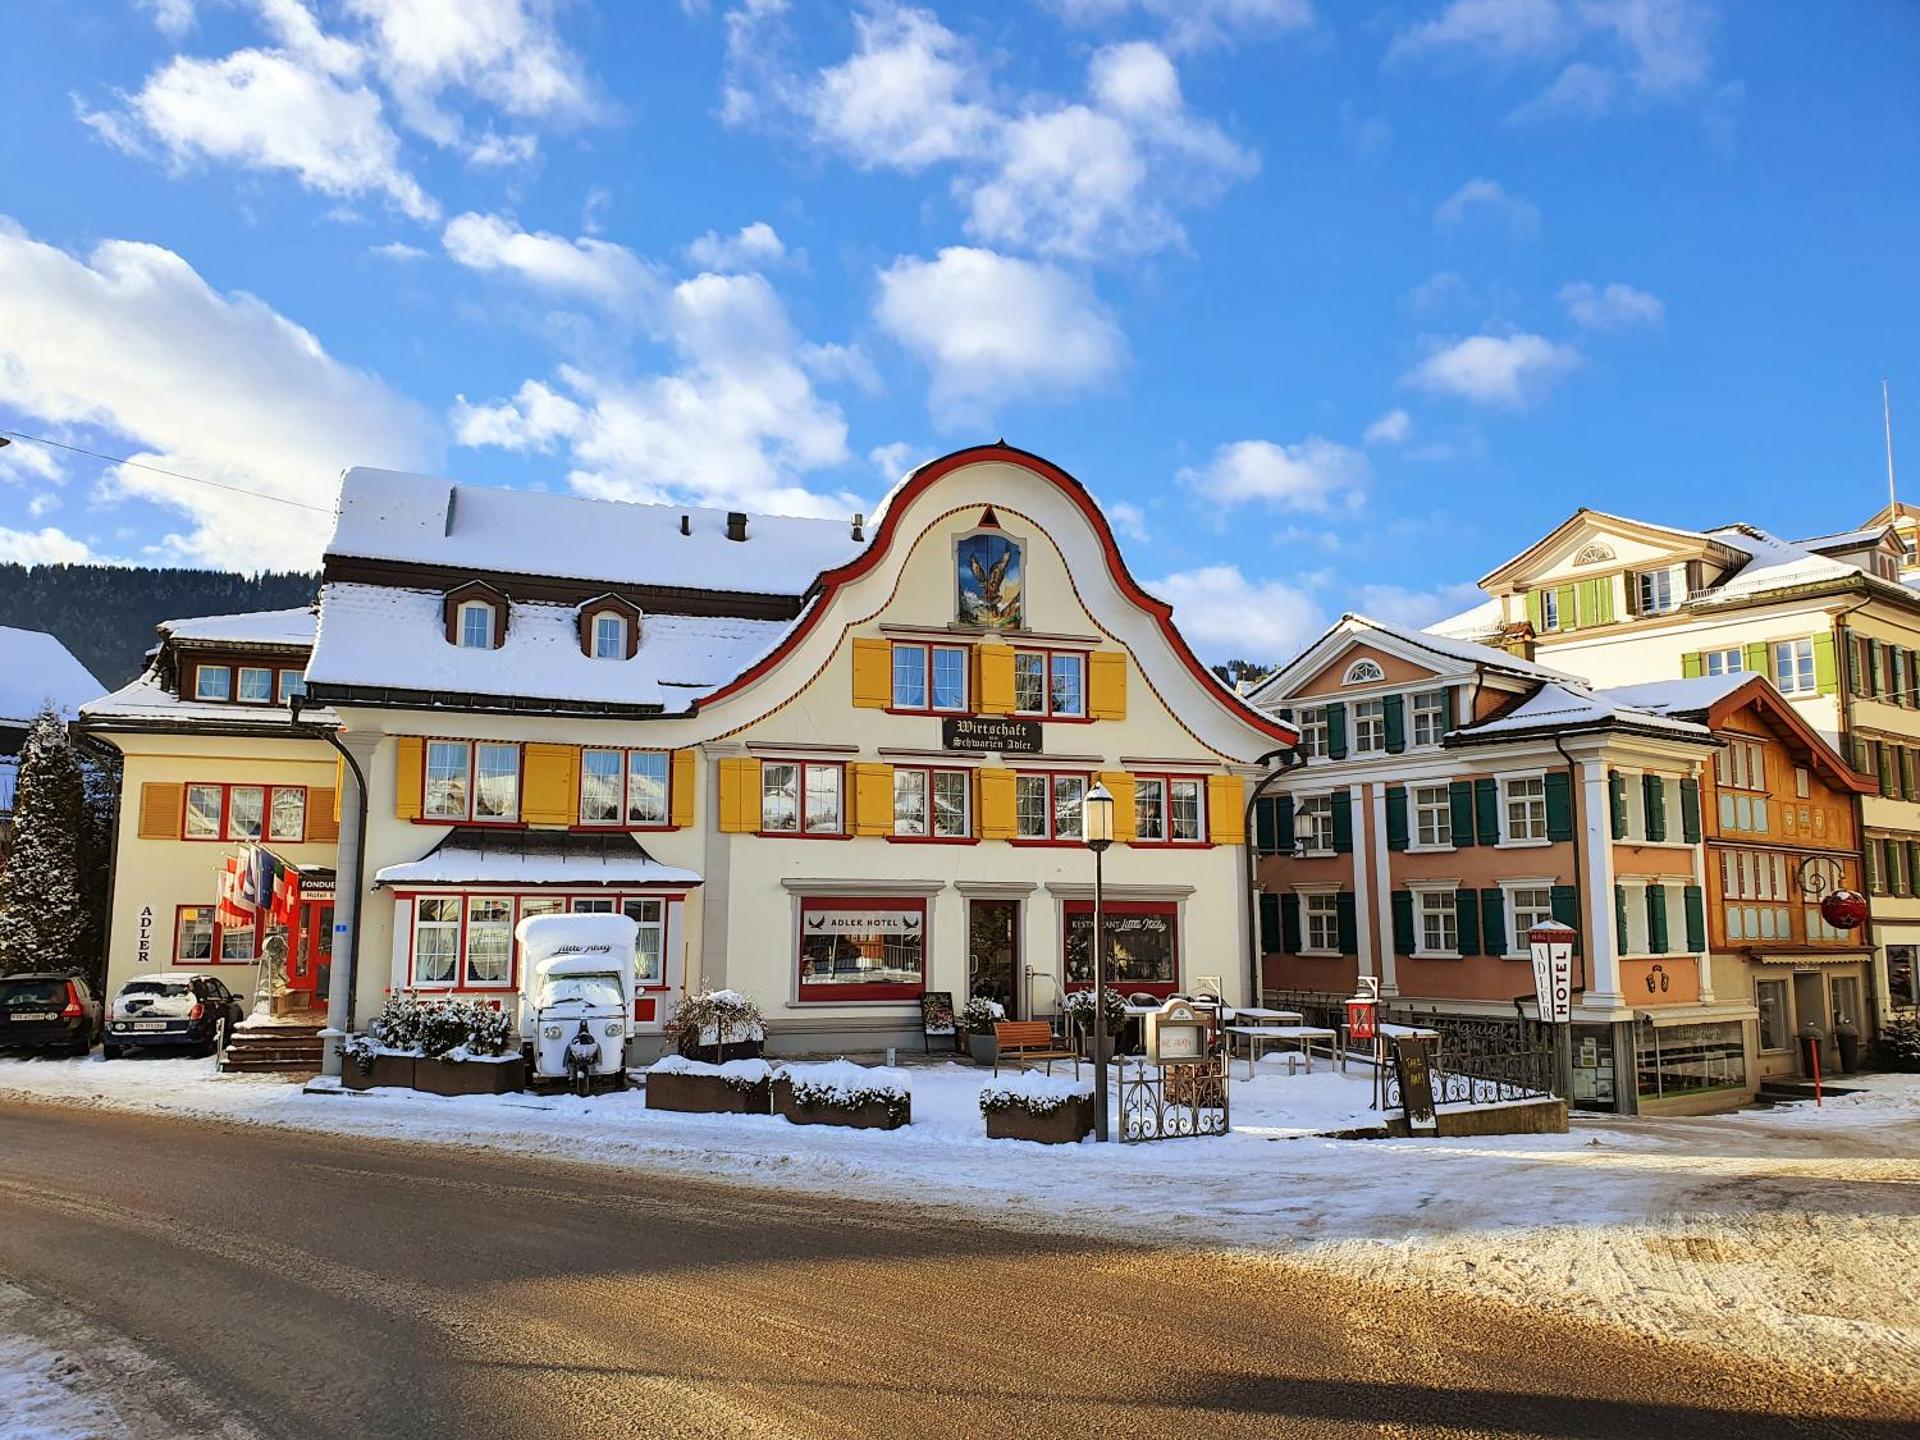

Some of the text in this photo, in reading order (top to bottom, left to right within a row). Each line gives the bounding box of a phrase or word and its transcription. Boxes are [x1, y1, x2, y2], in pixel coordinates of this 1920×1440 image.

[952, 736, 1003, 749] Schwarzen
[956, 720, 1027, 737] Wirtschaft
[138, 905, 153, 962] ADLER
[1537, 946, 1551, 1019] ADLER
[1556, 951, 1567, 1015] HOTEL
